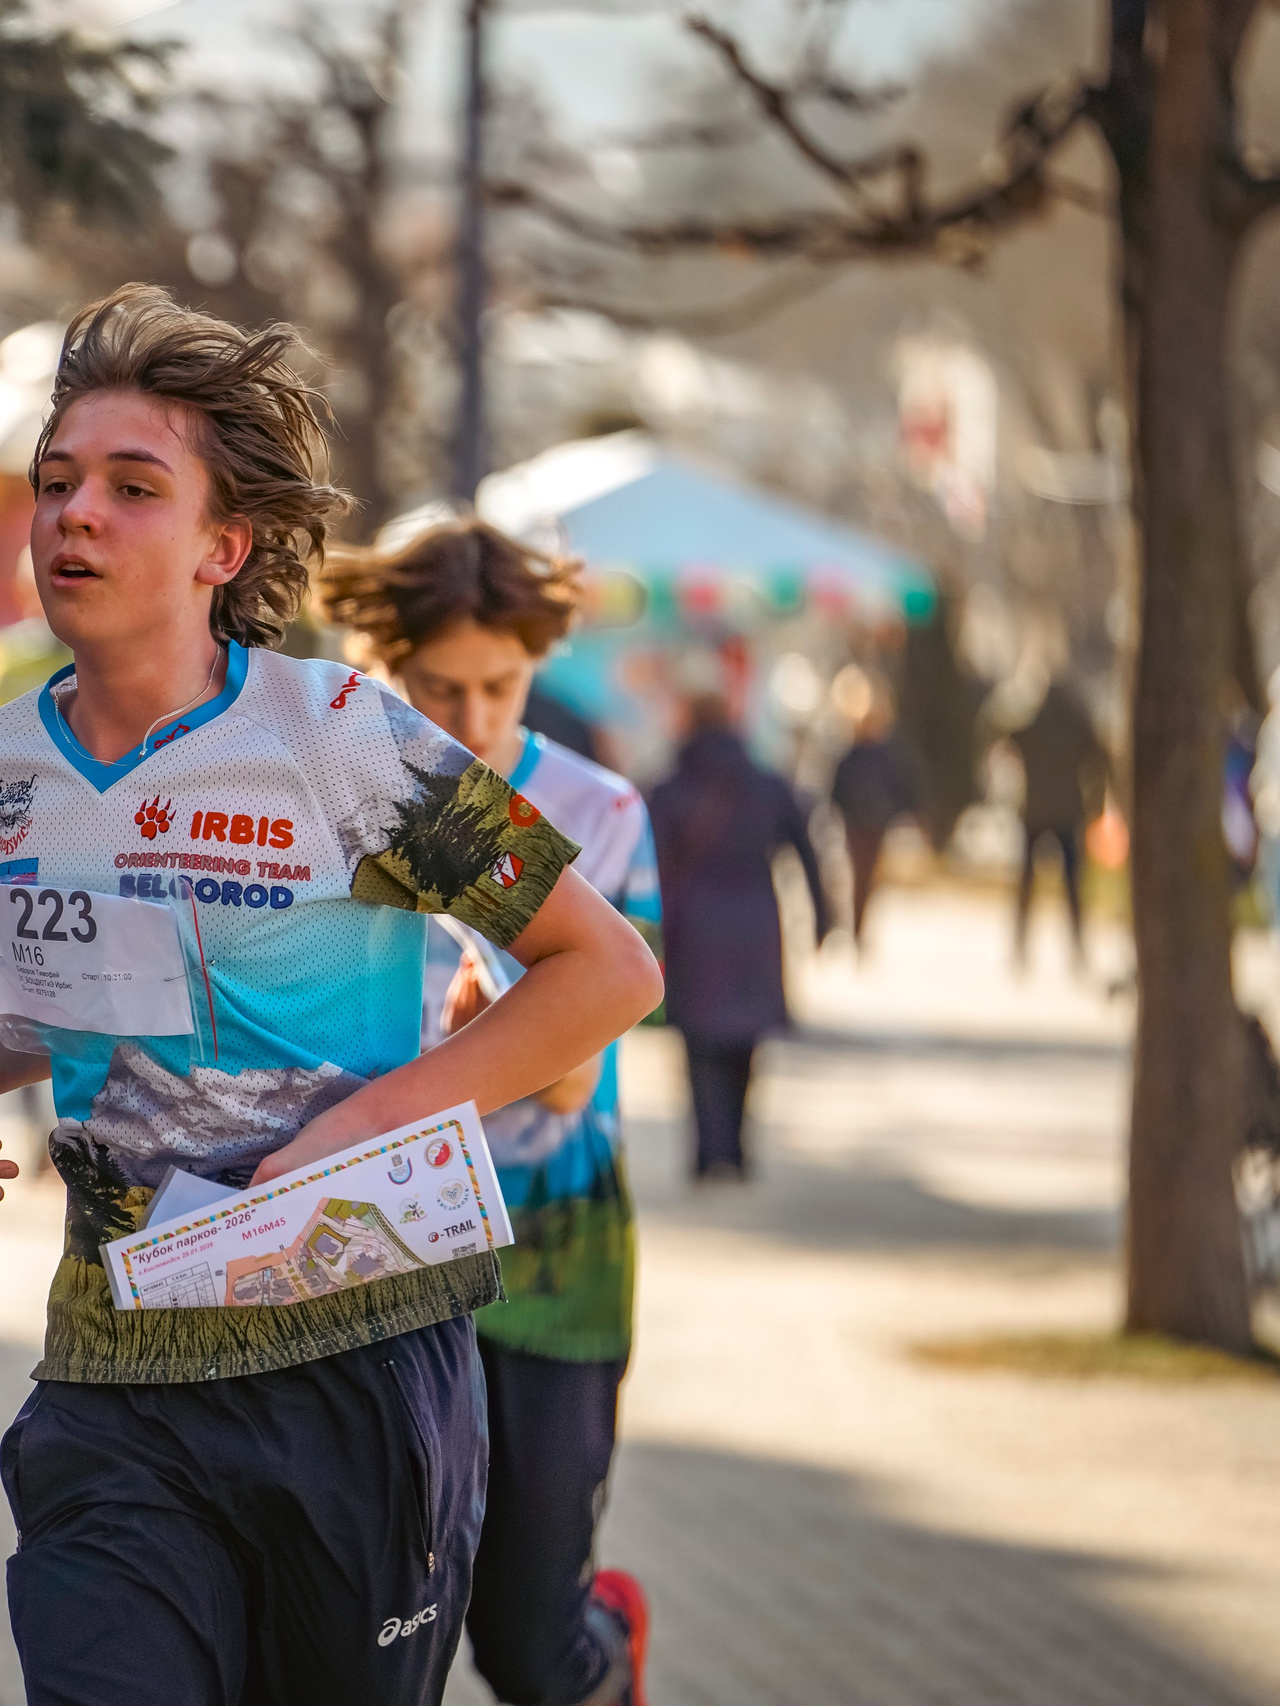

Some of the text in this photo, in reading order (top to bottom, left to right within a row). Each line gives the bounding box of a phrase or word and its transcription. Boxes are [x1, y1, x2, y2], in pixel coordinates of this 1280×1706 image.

[190, 811, 295, 849] IRBIS
[114, 851, 311, 881] ORIENTEERING TEAM
[9, 887, 98, 944] 223
[132, 1243, 174, 1265] "Кубок
[225, 1209, 257, 1230] 2026"
[400, 1602, 438, 1637] asics
